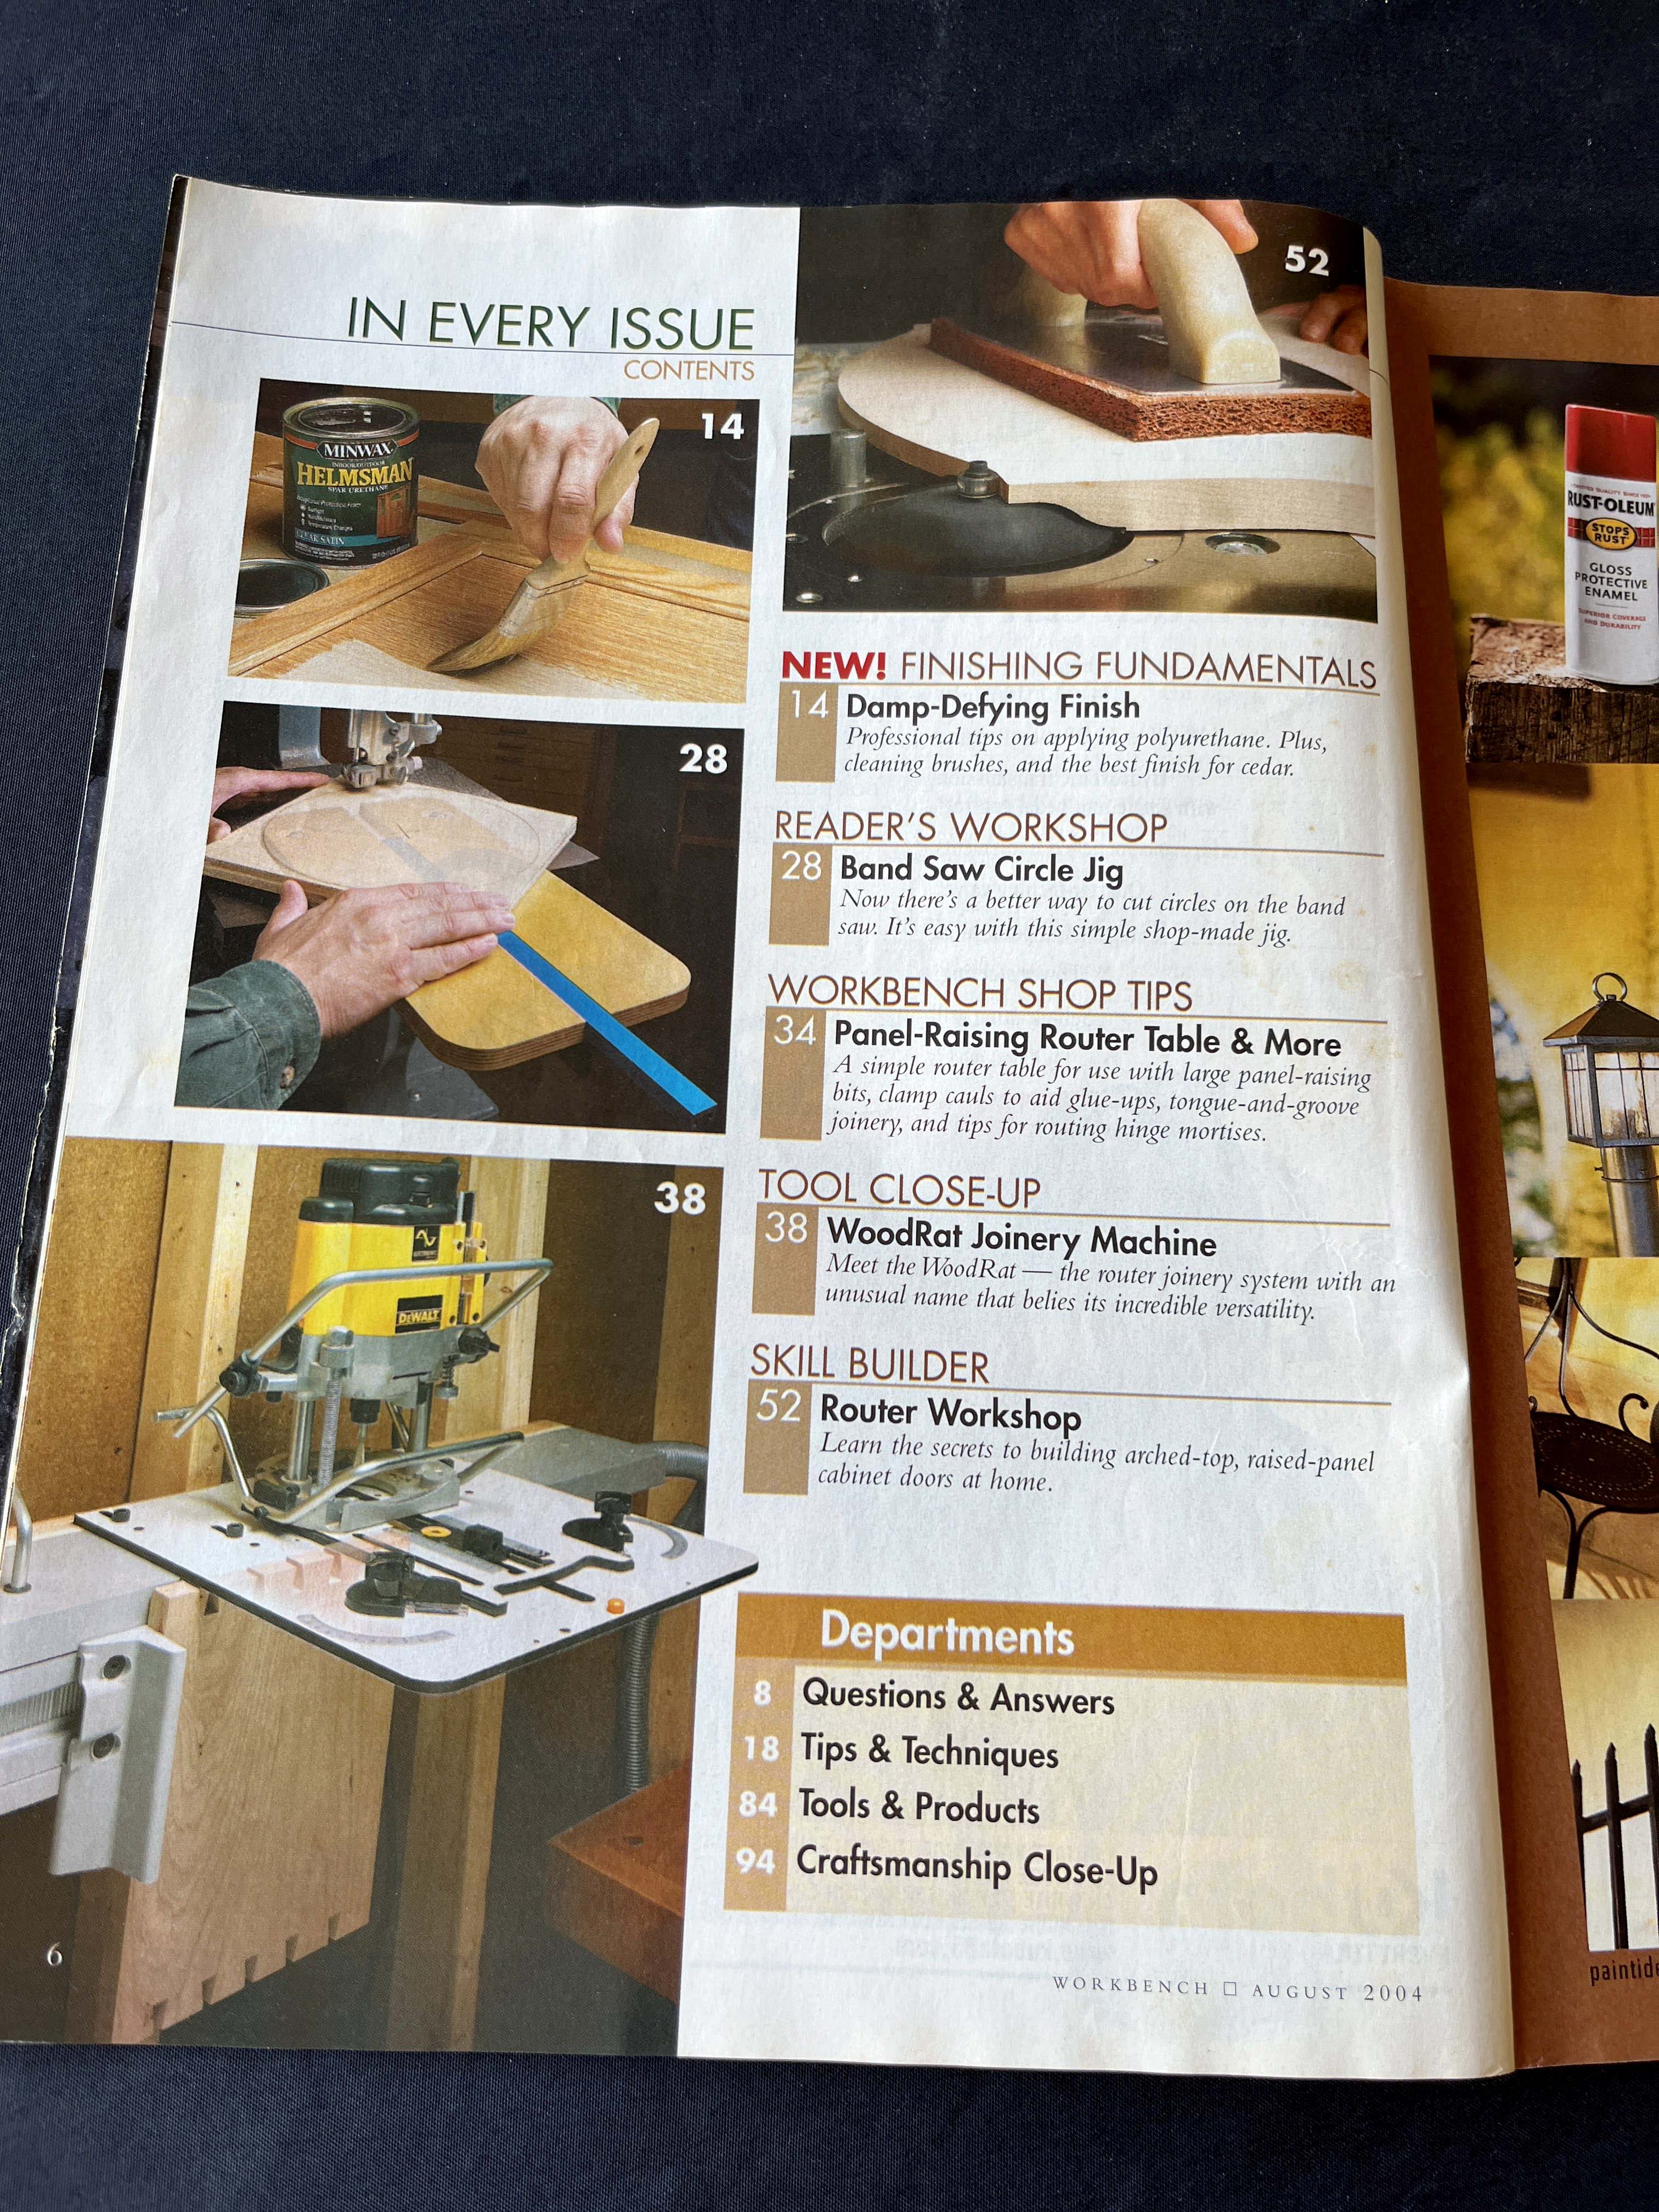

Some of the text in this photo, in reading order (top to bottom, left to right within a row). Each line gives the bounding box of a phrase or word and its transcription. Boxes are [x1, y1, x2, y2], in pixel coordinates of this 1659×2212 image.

[1285, 245, 1329, 276] 52
[348, 296, 754, 350] IN EVERY ISSUE
[624, 360, 754, 380] CONTENTS
[702, 414, 744, 439] 14
[297, 457, 414, 486] HELMSMAN
[1568, 490, 1655, 516] RUST-OLEUM
[320, 535, 345, 545] SATIN
[1592, 523, 1629, 536] STOPS
[1594, 533, 1629, 545] RUST
[1575, 572, 1647, 589] PROTECTIVE
[1590, 562, 1632, 576] GLOSS
[1585, 586, 1638, 601] ENAMEL
[1600, 620, 1641, 630] DURABILITY
[782, 651, 1376, 689] NEW! FINISHING FUNDAMENTALS
[792, 690, 828, 718] 14
[848, 691, 1139, 726] Damp-Defying Finish
[847, 726, 1326, 754] Professional tips on applying polyurethane. Plus,
[679, 743, 727, 774] 28
[845, 753, 1293, 780] cleaning brushes, and the best finish for cedar.
[950, 812, 1167, 843] WORKSHOP
[782, 851, 821, 880] 28
[842, 853, 1123, 890] Band Saw Circle Jig
[840, 889, 889, 907] Now
[967, 896, 977, 908] a
[986, 889, 1041, 909] better
[1048, 897, 1087, 915] way
[1097, 895, 1114, 910] to
[1124, 895, 1152, 910] cut
[1160, 892, 1216, 912] circles
[1224, 900, 1248, 912] on
[1259, 894, 1288, 913] the
[1297, 895, 1345, 915] band
[768, 973, 1192, 1012] WORKBENCH SHOP TIPS
[775, 1015, 816, 1045] 34
[836, 1018, 1341, 1057] Panel-Raising Router Table & More
[833, 1054, 1371, 1093] A simple router table for use with large panel-raising
[833, 1081, 1359, 1120] bits, clamp cauls to aid glue-ups, tongue-and-groove
[826, 1110, 1265, 1144] joinery, and tips for routing hinge mortises.
[654, 1181, 706, 1215] 38
[759, 1169, 1040, 1208] TOOL CLOSE-UP
[766, 1211, 806, 1243] 38
[827, 1217, 1216, 1260] WoodRat Joinery Machine
[826, 1253, 1395, 1294] Meet the WoodRat the router joinery system with an
[826, 1284, 1314, 1325] unusual name that belies its incredible versatility.
[751, 1343, 989, 1384] SKILL BUILDER
[757, 1390, 800, 1421] 52
[822, 1393, 1081, 1440] Router Workshop
[821, 1432, 1374, 1477] Learn the secrets to building arched-top, raised-panel
[822, 1610, 1074, 1662] Departments
[754, 1681, 771, 1706] 8
[803, 1677, 1114, 1715] Questions & Answers
[745, 1736, 778, 1762] 18
[801, 1732, 1058, 1776] Tips & Techniques
[740, 1792, 777, 1817] 84
[799, 1786, 1040, 1824] Tools & Products
[736, 1849, 775, 1874] 94
[797, 1842, 1158, 1895] Craftsmanship Close-Up
[47, 1942, 62, 1966] 6
[1053, 1977, 1421, 2001] WORKBENCH AUGUST 2004
